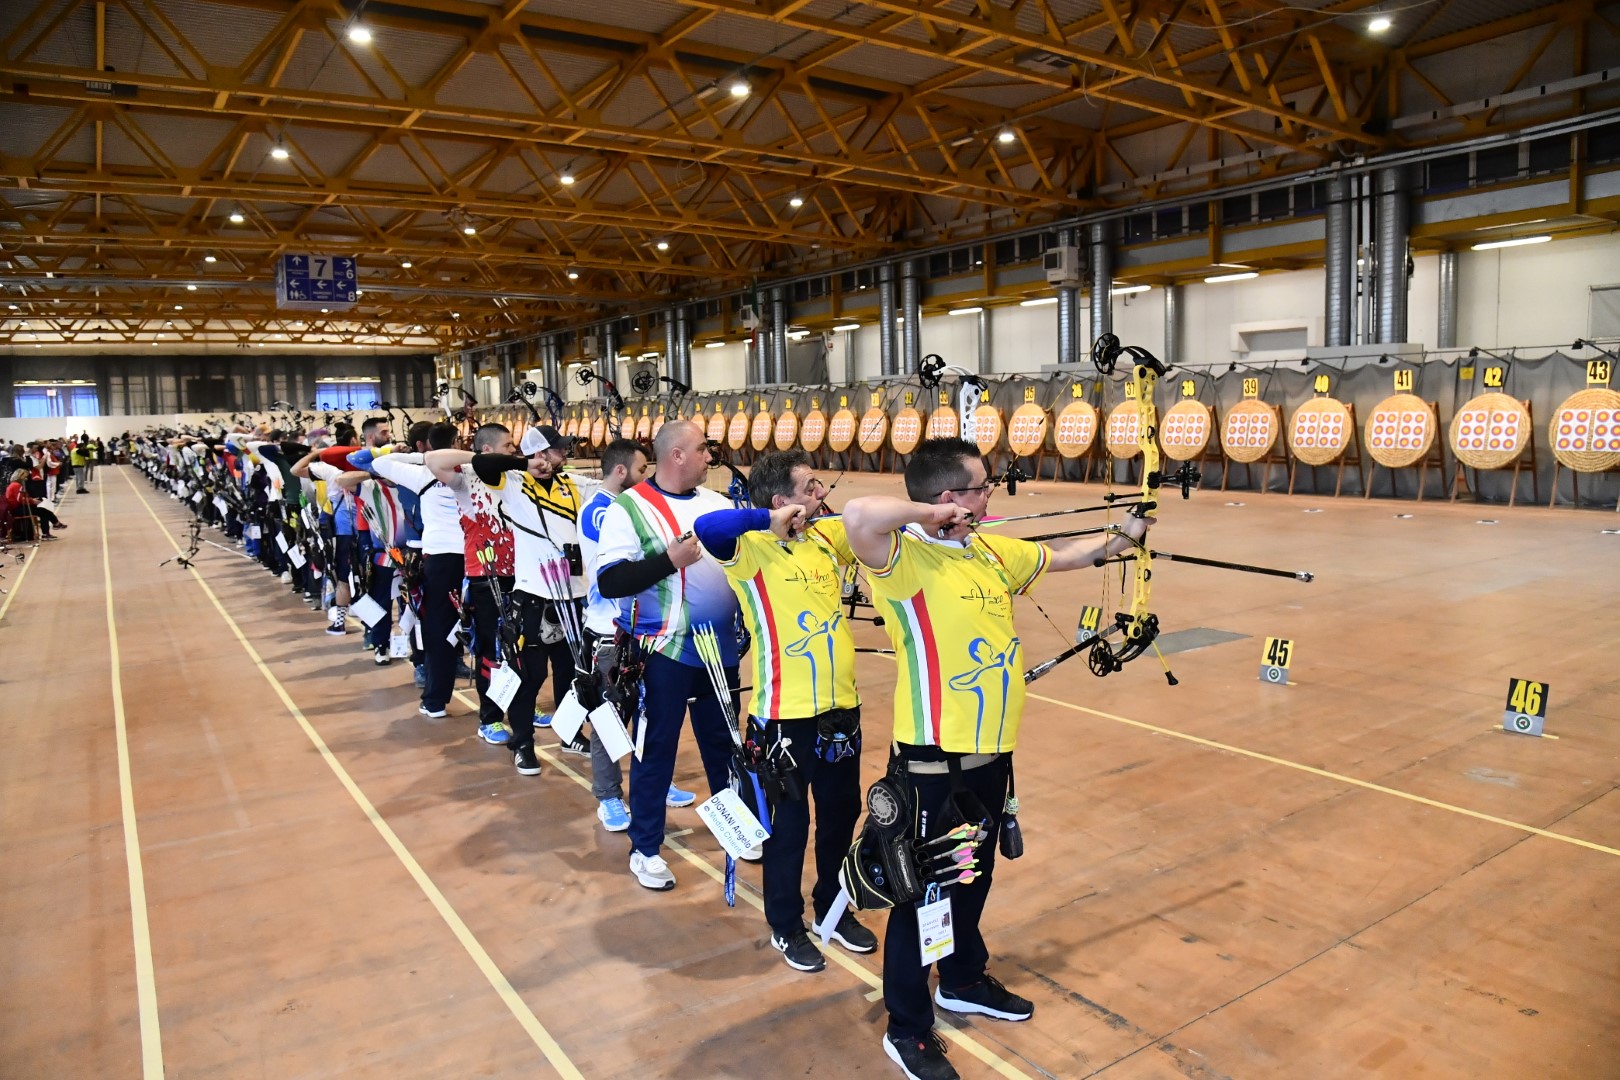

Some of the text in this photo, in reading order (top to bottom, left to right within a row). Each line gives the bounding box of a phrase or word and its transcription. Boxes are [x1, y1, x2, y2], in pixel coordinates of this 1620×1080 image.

[314, 259, 327, 277] 7
[346, 270, 354, 279] 6
[348, 291, 356, 302] 8
[1398, 370, 1408, 386] 41
[1484, 367, 1502, 386] 42
[1588, 361, 1608, 380] 43
[1025, 387, 1034, 398] 35
[1182, 380, 1194, 396] 38
[1244, 380, 1256, 394] 39
[1314, 376, 1329, 392] 40
[845, 566, 856, 584] 42
[1081, 606, 1099, 631] 44
[1267, 638, 1290, 666] 45
[1510, 680, 1542, 716] 46
[711, 796, 752, 848] DIGNANI Angelo
[709, 811, 725, 832] Medio
[724, 831, 744, 854] Chienti
